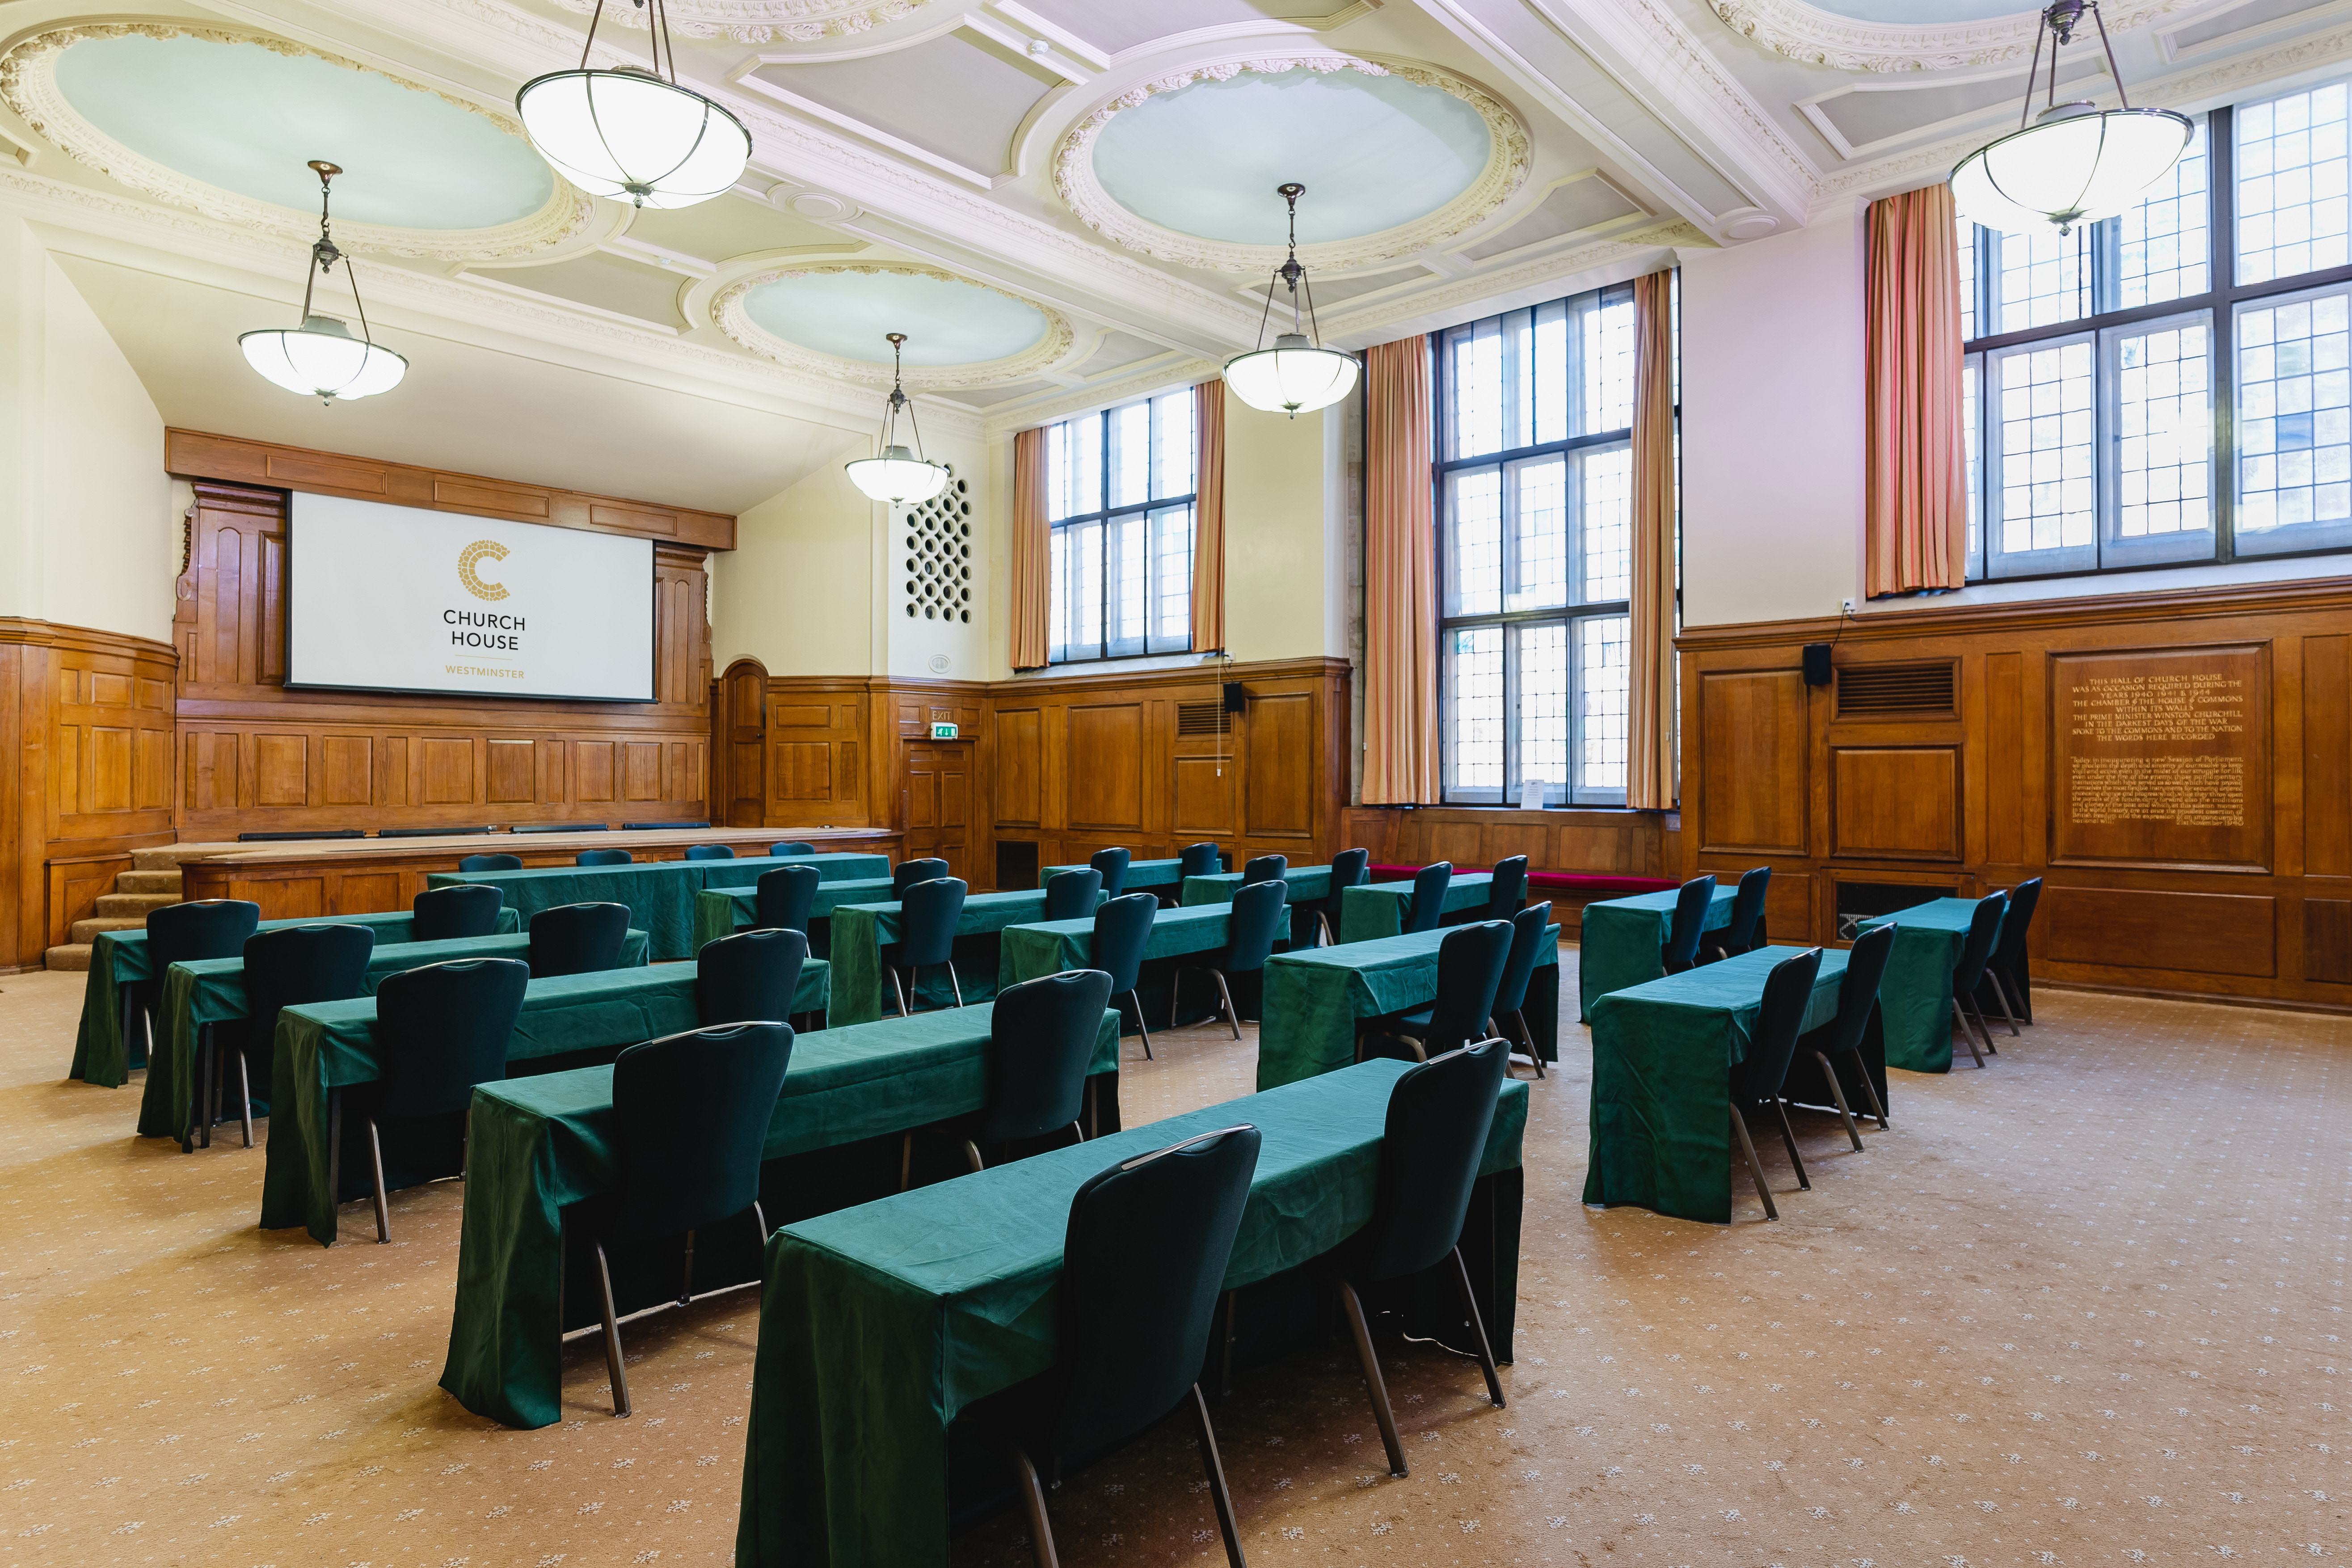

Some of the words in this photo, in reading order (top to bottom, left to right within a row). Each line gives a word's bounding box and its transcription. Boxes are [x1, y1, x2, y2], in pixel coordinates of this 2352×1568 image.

[443, 610, 525, 631] CHURCH
[452, 631, 518, 650] HOUSE
[446, 665, 524, 679] WESTMINSTER
[2148, 675, 2187, 683] CHURCH
[2103, 684, 2145, 692] OCCASION
[2148, 682, 2190, 691] REQUIRED
[2193, 681, 2226, 689] DURING
[2158, 696, 2186, 704] HOUSE
[2198, 695, 2243, 703] COMMONS
[933, 711, 951, 720] EXIT
[2171, 733, 2215, 741] RECORDED
